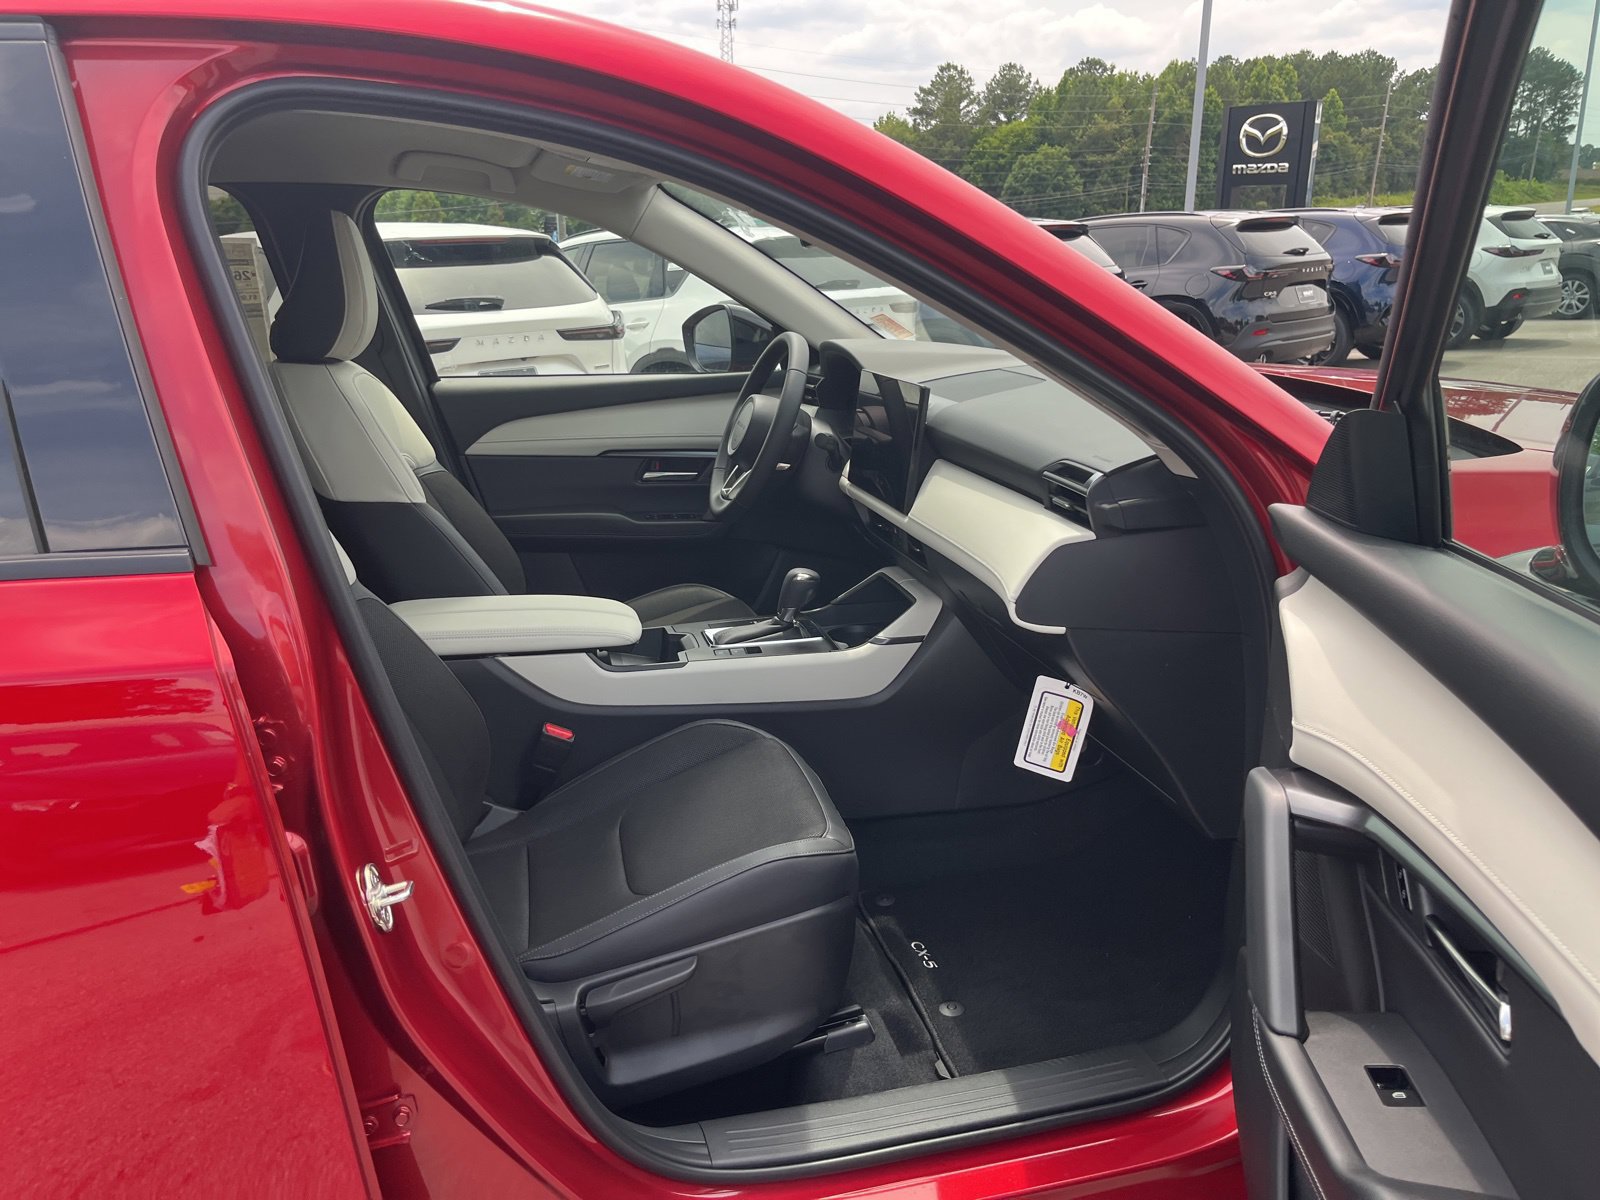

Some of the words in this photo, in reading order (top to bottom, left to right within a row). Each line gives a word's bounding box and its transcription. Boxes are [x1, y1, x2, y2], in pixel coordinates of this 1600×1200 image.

[474, 333, 545, 348] MAZDA
[1061, 738, 1071, 757] Equipped
[910, 941, 939, 969] CX-5
